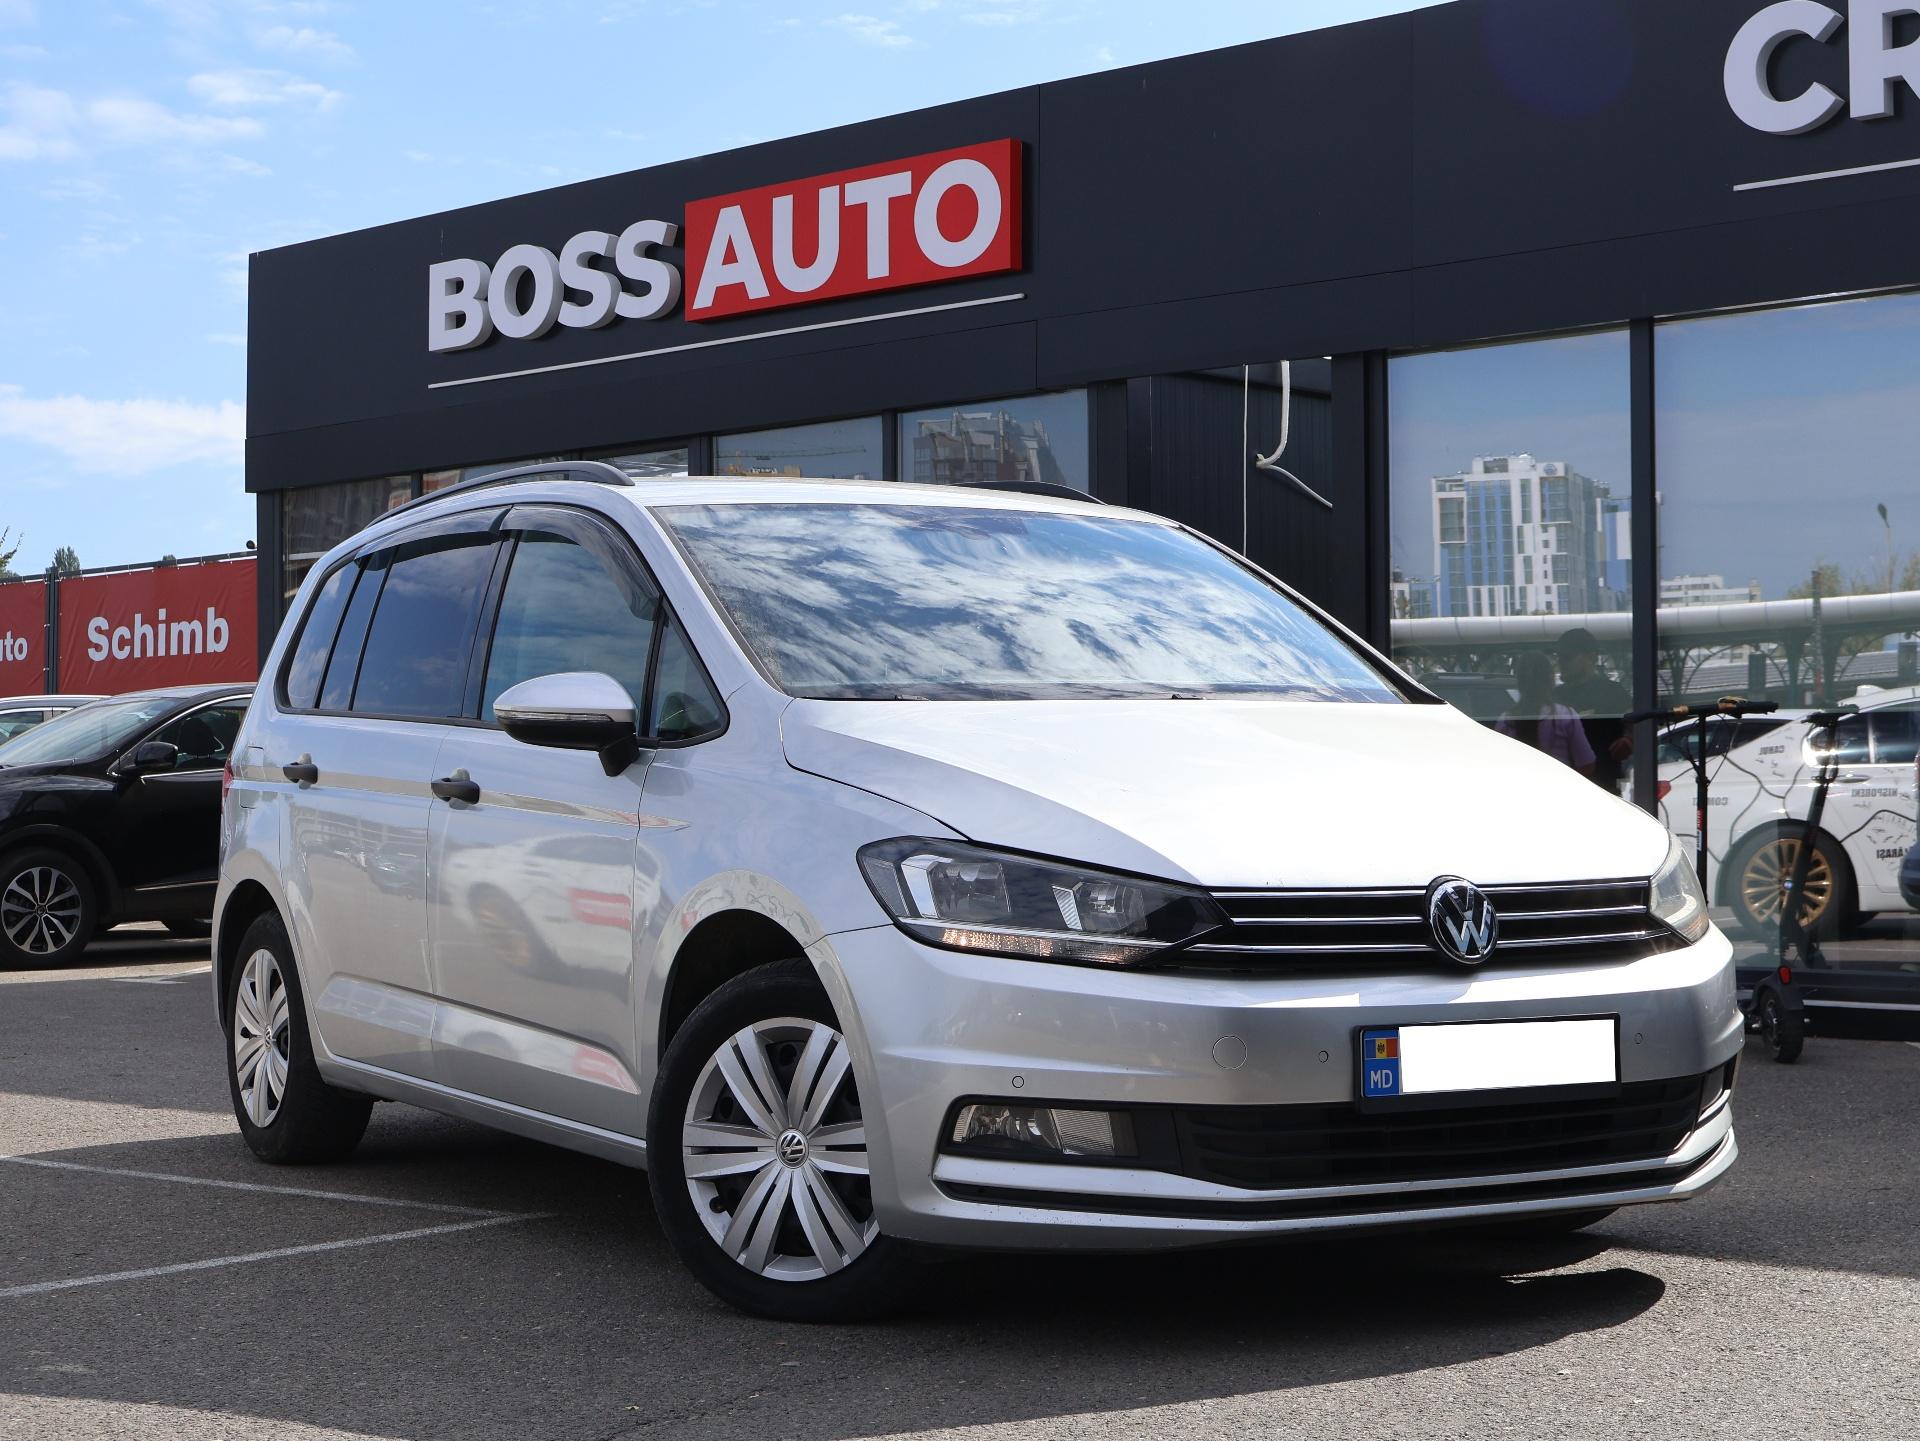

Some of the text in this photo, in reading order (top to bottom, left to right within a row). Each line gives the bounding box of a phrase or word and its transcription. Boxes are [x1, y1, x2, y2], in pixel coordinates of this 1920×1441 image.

[429, 158, 1002, 353] BOSS AUTO
[87, 607, 229, 662] Schimb
[1370, 1069, 1393, 1089] MD
